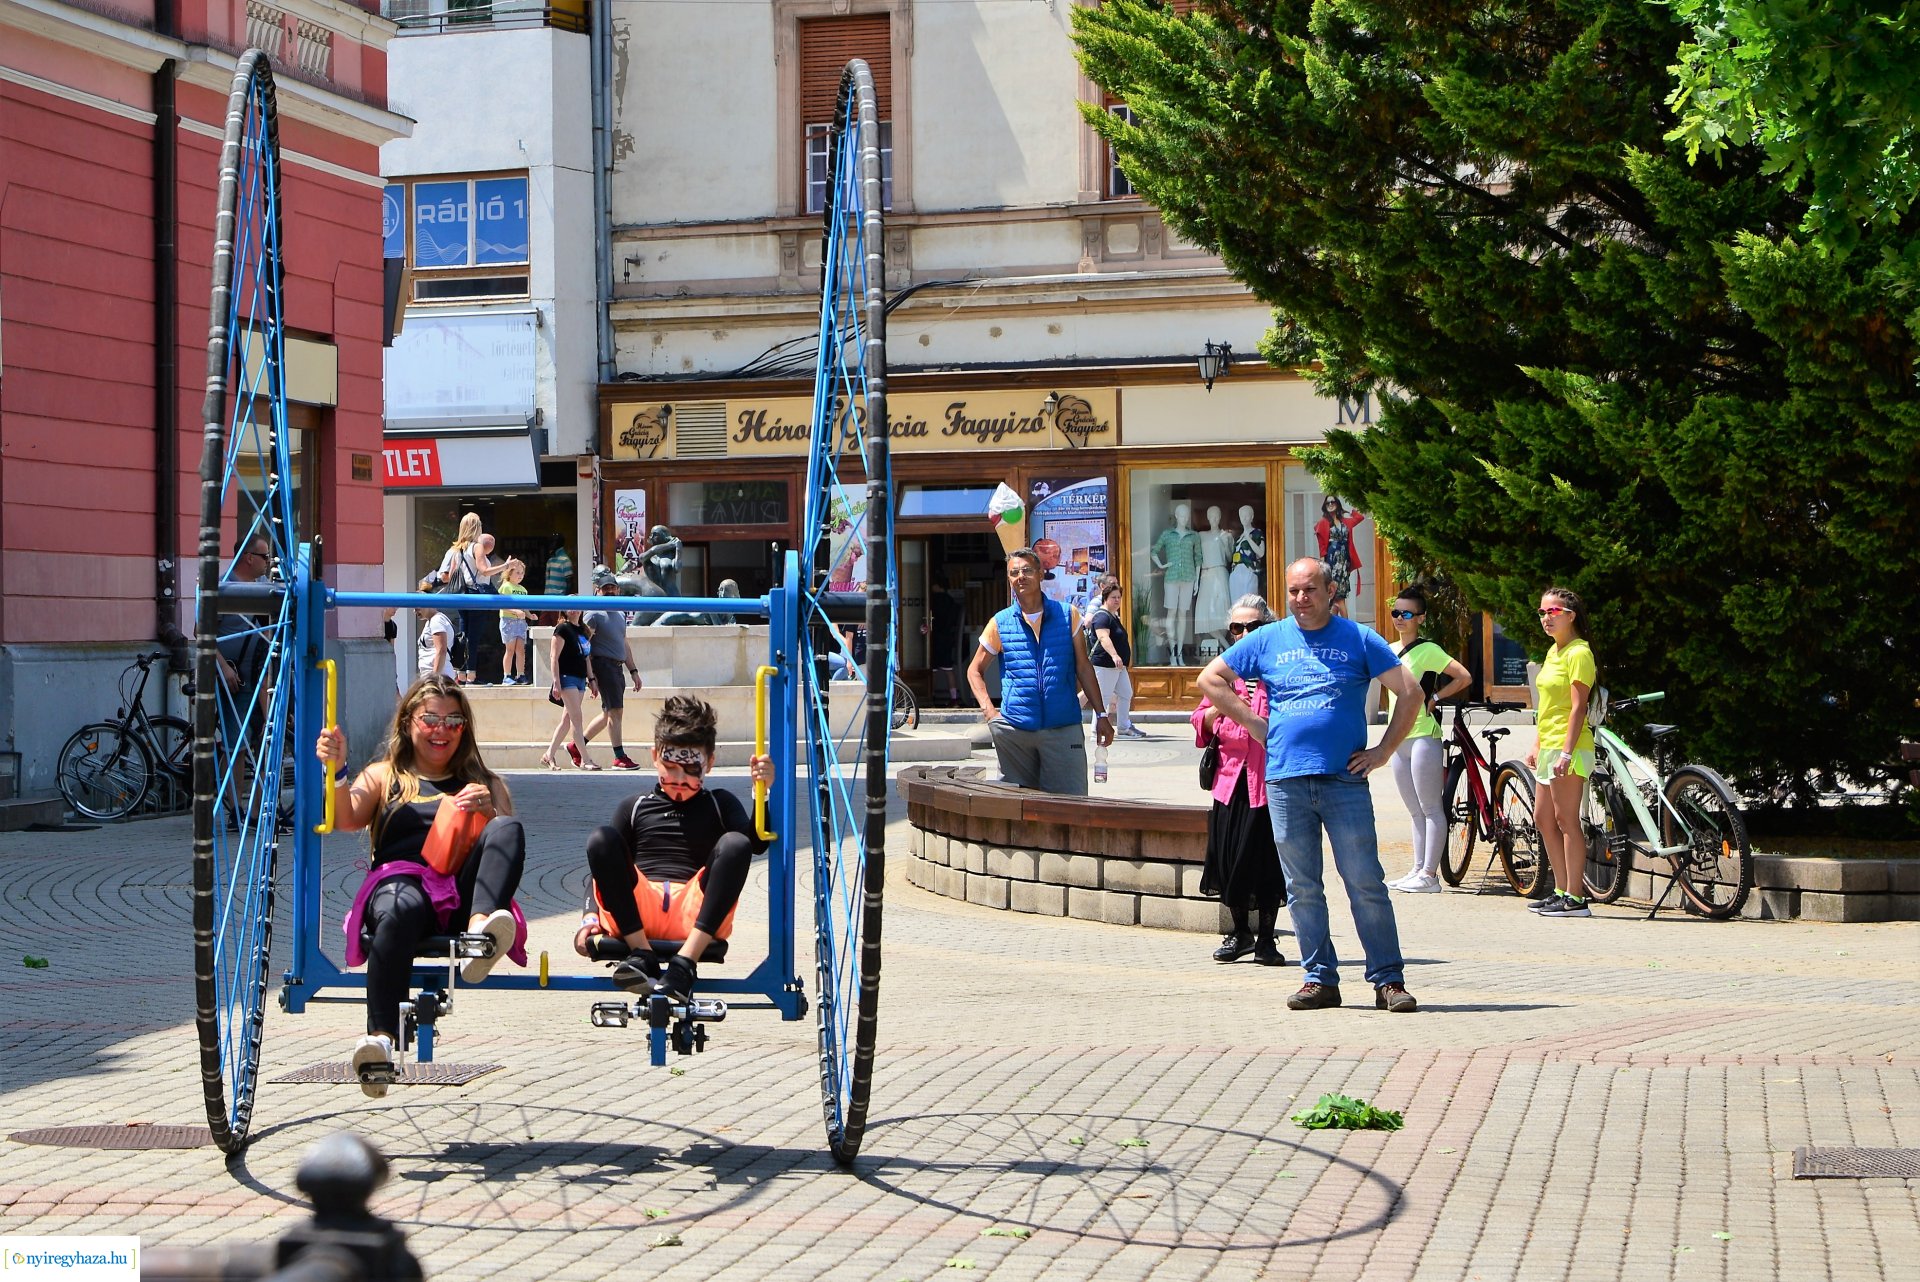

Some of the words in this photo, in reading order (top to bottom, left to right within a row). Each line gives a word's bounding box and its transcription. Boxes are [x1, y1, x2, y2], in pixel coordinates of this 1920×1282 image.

[513, 199, 524, 220] 1
[732, 409, 815, 443] Háro
[941, 401, 1046, 443] Fagyizó
[1063, 418, 1110, 437] Fagyizó
[618, 432, 661, 450] Fagyizó
[1060, 492, 1107, 505] TÉRKÉP
[1275, 647, 1349, 667] ATHLETES
[1289, 673, 1326, 684] COURAGE
